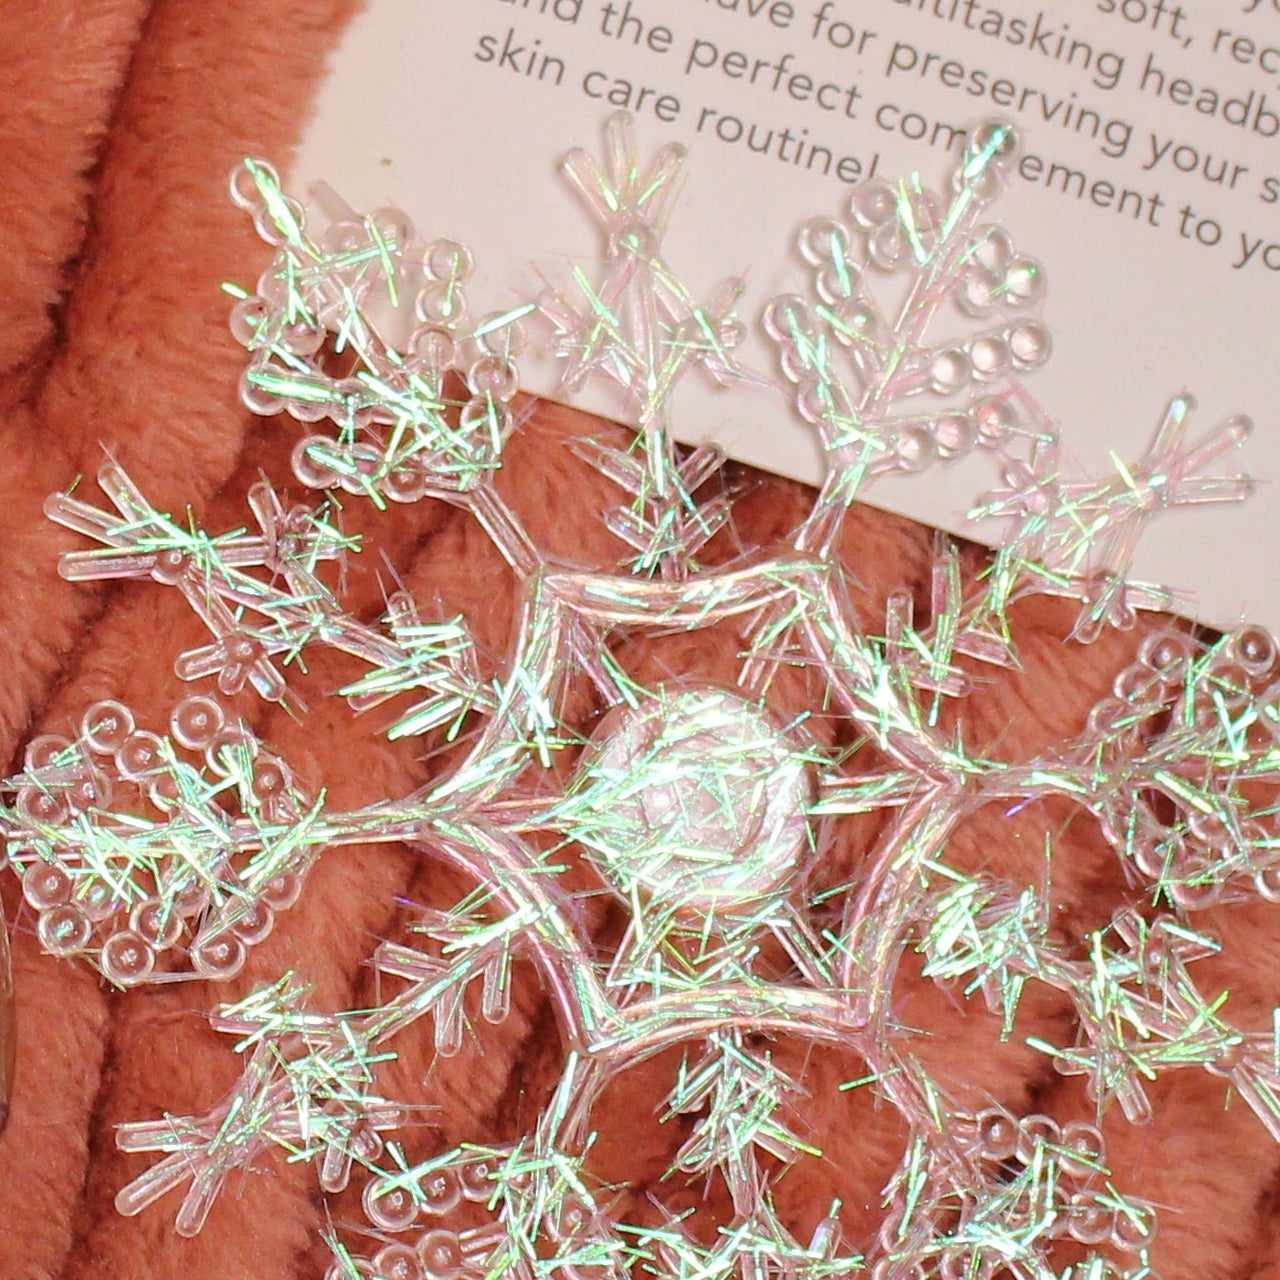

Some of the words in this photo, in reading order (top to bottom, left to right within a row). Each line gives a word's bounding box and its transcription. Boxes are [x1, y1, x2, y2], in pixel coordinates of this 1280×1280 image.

[474, 27, 566, 86] skin
[583, 69, 682, 124] care
[813, 1, 877, 55] for
[886, 41, 1133, 158] preserving
[1142, 133, 1248, 189] your
[1140, 52, 1280, 137] headb
[1212, 28, 1280, 74] rec
[601, 1, 674, 54] the
[685, 36, 863, 119] perfect
[876, 102, 1165, 227] comement
[1180, 205, 1222, 248] to
